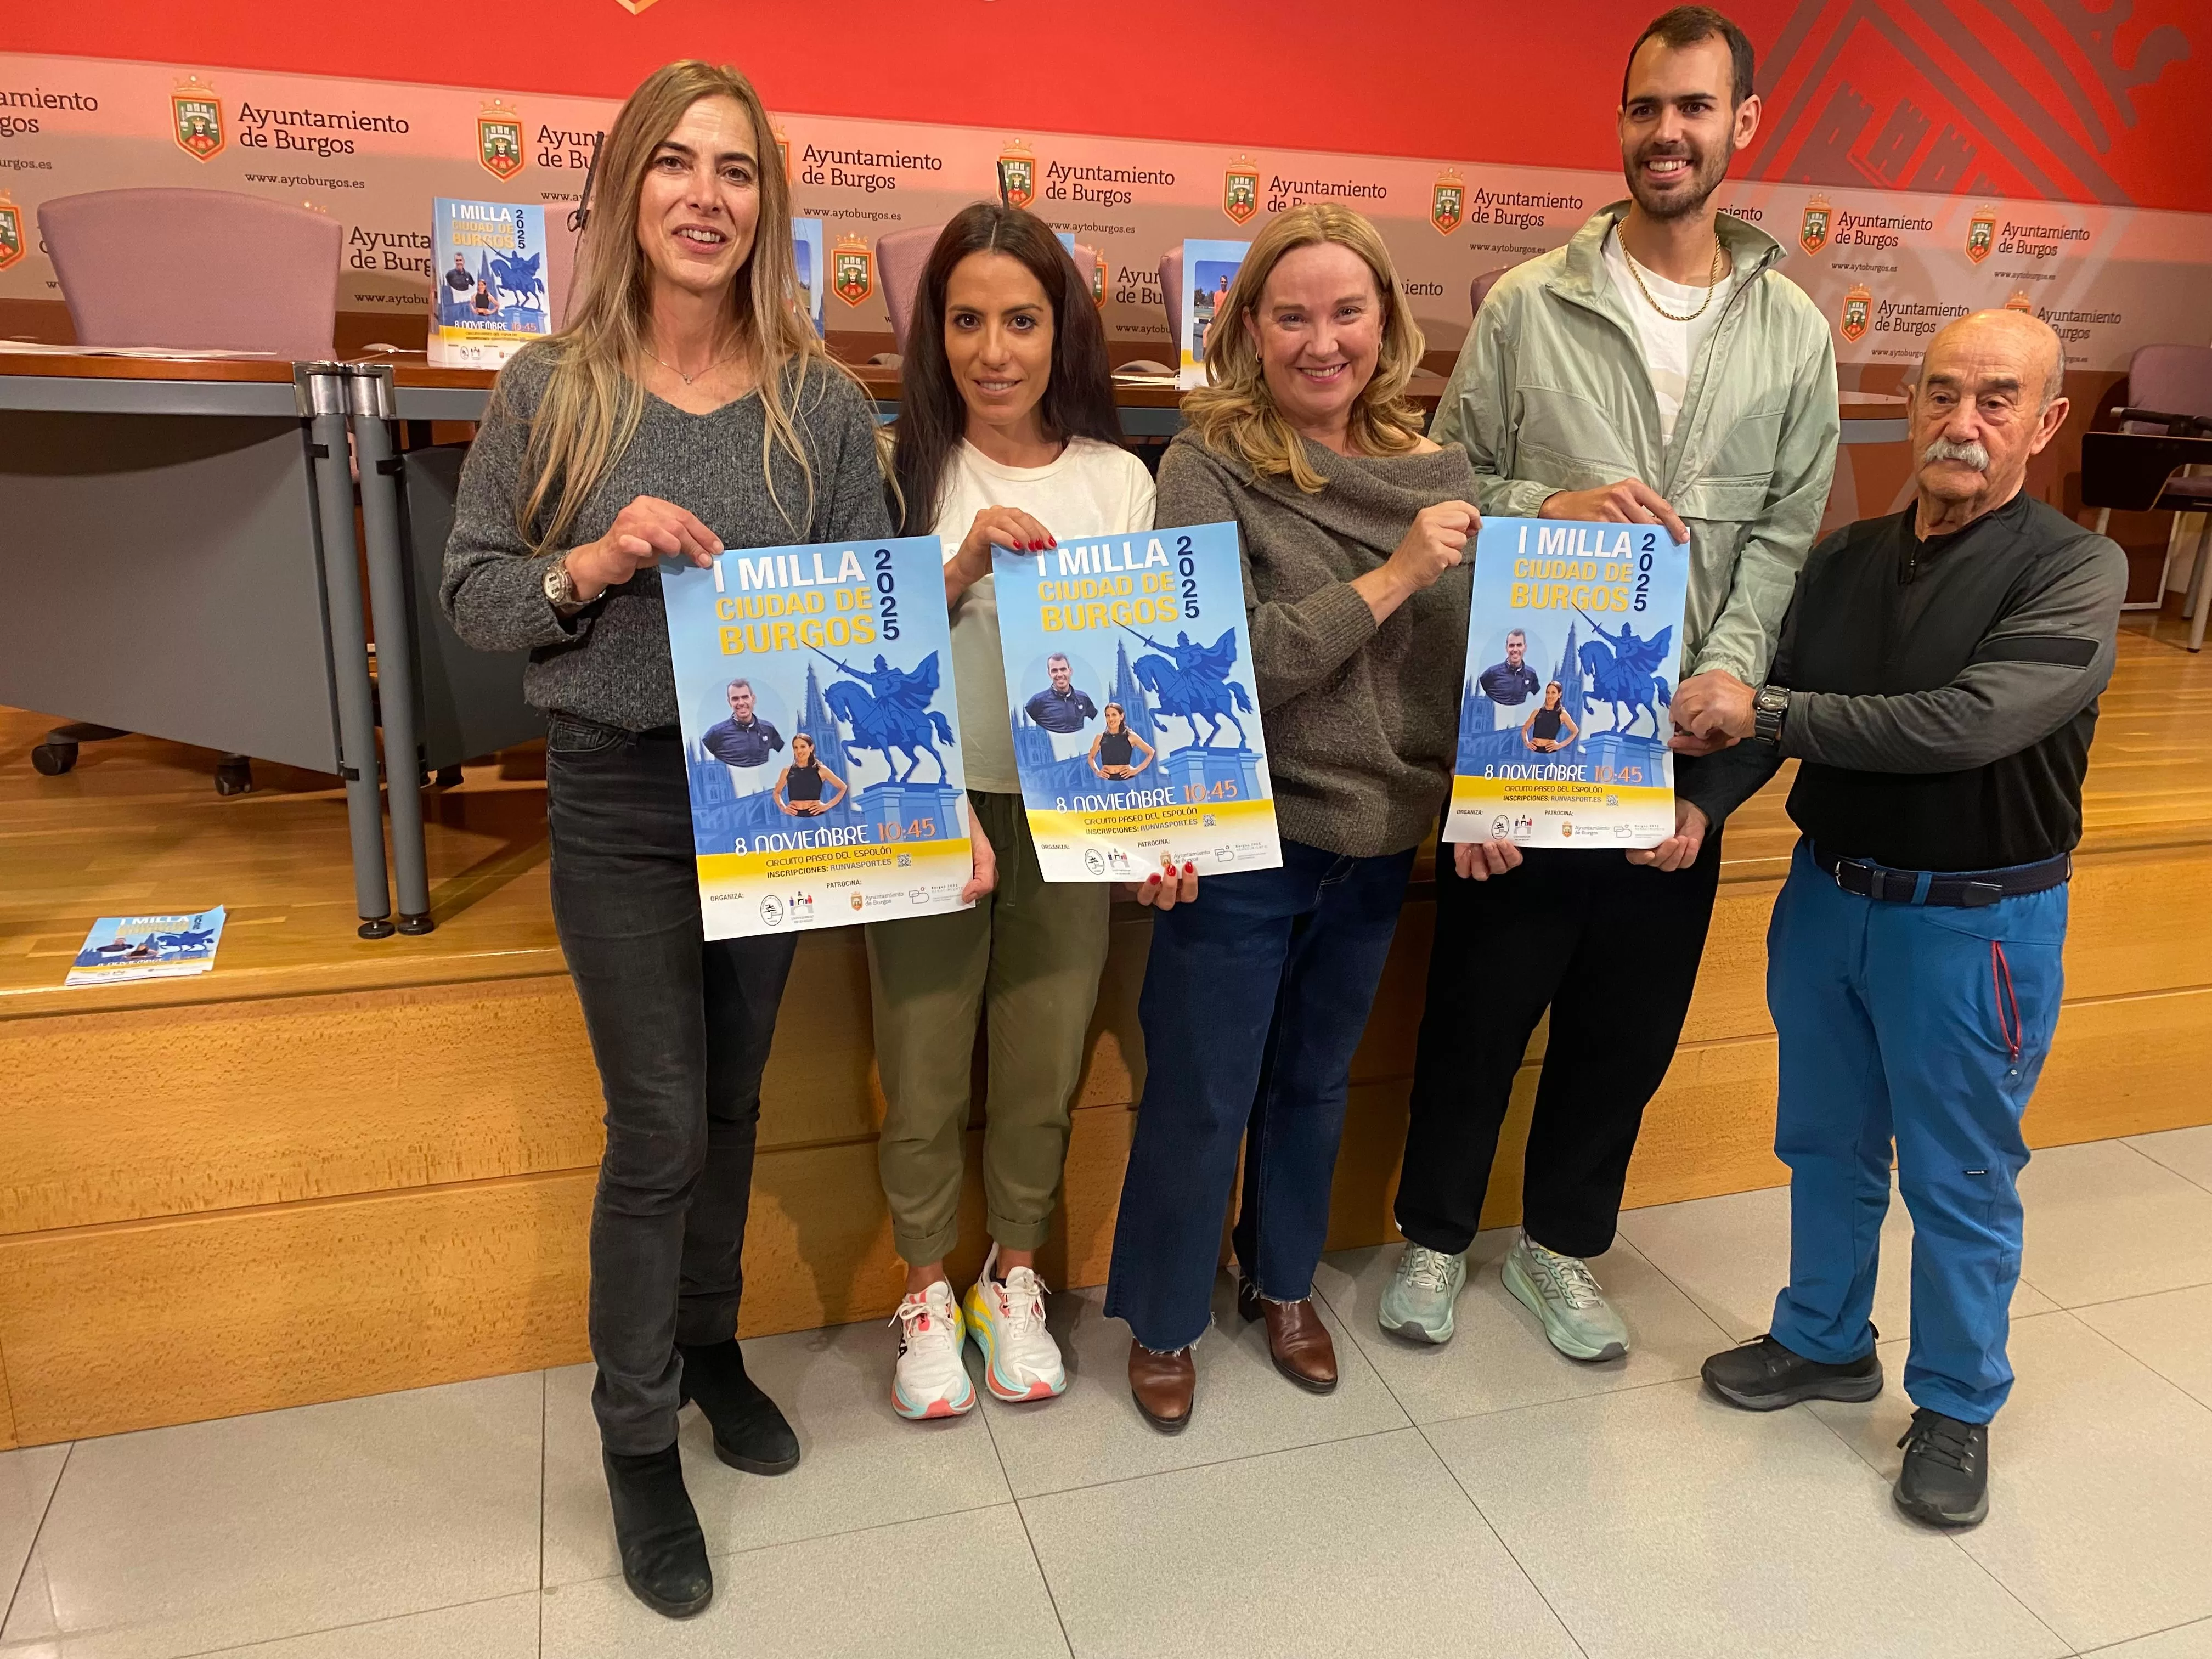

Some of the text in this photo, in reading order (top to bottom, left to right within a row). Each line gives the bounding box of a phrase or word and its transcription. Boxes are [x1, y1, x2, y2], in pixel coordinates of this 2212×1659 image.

[238, 102, 409, 133] Ayuntamiento
[240, 126, 354, 157] de Burgos
[537, 146, 562, 167] de
[802, 144, 942, 170] Ayuntamiento
[245, 173, 365, 189] www.aytoburgos.es
[802, 167, 895, 193] de Burgos
[1046, 161, 1175, 187] Ayuntamiento
[1046, 182, 1131, 206] de Burgos
[1268, 176, 1387, 198] Ayuntamiento
[1267, 195, 1286, 212] de
[1474, 188, 1583, 210] Ayuntamiento
[452, 204, 512, 222] I MILLA
[803, 208, 901, 221] www.aytoburgos.es
[1471, 208, 1544, 230] de Burgos
[1838, 211, 1933, 232] Ayuntamiento
[452, 219, 515, 234] CIUDAD DE
[516, 209, 526, 249] 2025
[1046, 222, 1135, 234] www.aytoburgos.es
[2001, 222, 2090, 241] Ayuntamiento
[453, 232, 515, 249] BURGOS
[1470, 243, 1545, 255] www.aytoburgos.es
[1835, 231, 1899, 250] de Burgos
[1998, 240, 2057, 259] de Burgos
[350, 250, 376, 269] de
[1831, 262, 1898, 273] www.aytoburgos.es
[1116, 285, 1136, 303] de
[1877, 300, 1970, 318] Ayuntamiento
[2037, 307, 2121, 325] Ayuntamiento
[462, 320, 508, 331] NOVIEMBRE
[1875, 316, 1936, 336] de Burgos
[1519, 526, 1633, 558] I MILLA
[1037, 538, 1169, 576] I MILLA
[714, 550, 866, 592] I MILLA
[1177, 535, 1200, 618] 2025
[1514, 558, 1634, 582] CIUDAD DE
[1634, 533, 1656, 612] 2025
[874, 549, 900, 641] 2025
[1038, 571, 1176, 601] CIUDAD DE
[716, 587, 873, 620] CIUDAD DE
[1510, 582, 1629, 612] BURGOS
[1041, 596, 1179, 631] BURGOS
[719, 615, 877, 655] BURGOS
[1484, 763, 1643, 783] 8 NOVIEMBRE 10:45
[1057, 780, 1238, 814] 8 NOVIEMBRE 10:45
[1572, 785, 1602, 793] ESPOLÓN
[1084, 808, 1198, 825] CIRCUITO PASEO DEL ESPOLÓN
[735, 818, 936, 856] 8 NOVIEMBRE 10:45
[1086, 818, 1198, 836] INSCRIPCIONES: RUNVASPORT.ES
[1137, 839, 1170, 847] PATROCINA:
[766, 845, 892, 867] CIRCUITO PASEO DEL ESPOLÓN
[1174, 850, 1210, 859] Ayuntamiento
[767, 858, 891, 879] INSCRIPCIONES: RUNVASPORT.ES
[826, 880, 862, 889] PATROCINA:
[710, 893, 744, 901] ORGANIZA:
[865, 891, 904, 902] Ayuntamiento
[132, 916, 189, 924] MILLA
